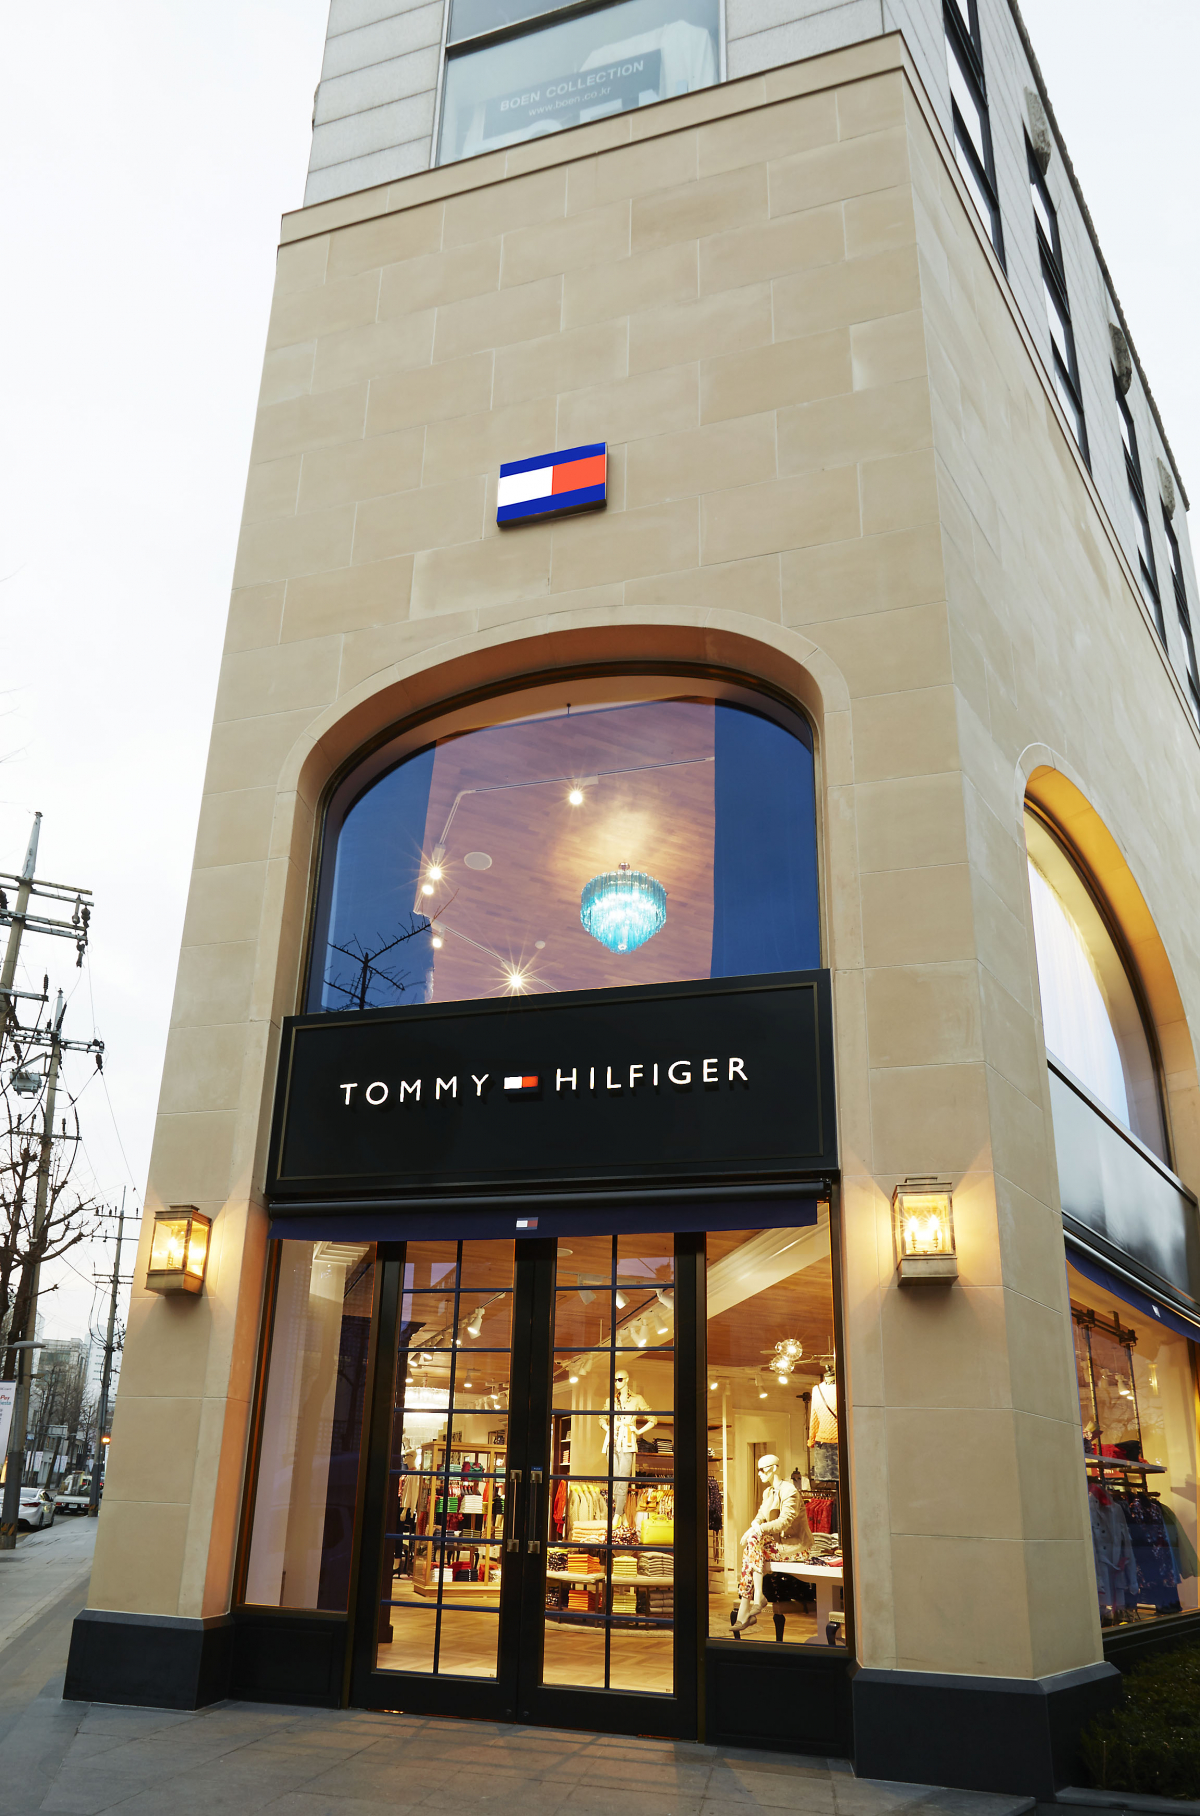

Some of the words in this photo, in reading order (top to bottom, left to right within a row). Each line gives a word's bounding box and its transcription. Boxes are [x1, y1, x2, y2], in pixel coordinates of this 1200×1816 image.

[500, 91, 541, 111] BOEN
[546, 60, 644, 98] COLLECTION
[340, 1074, 489, 1105] TOMMY
[556, 1058, 748, 1091] HILFIGER
